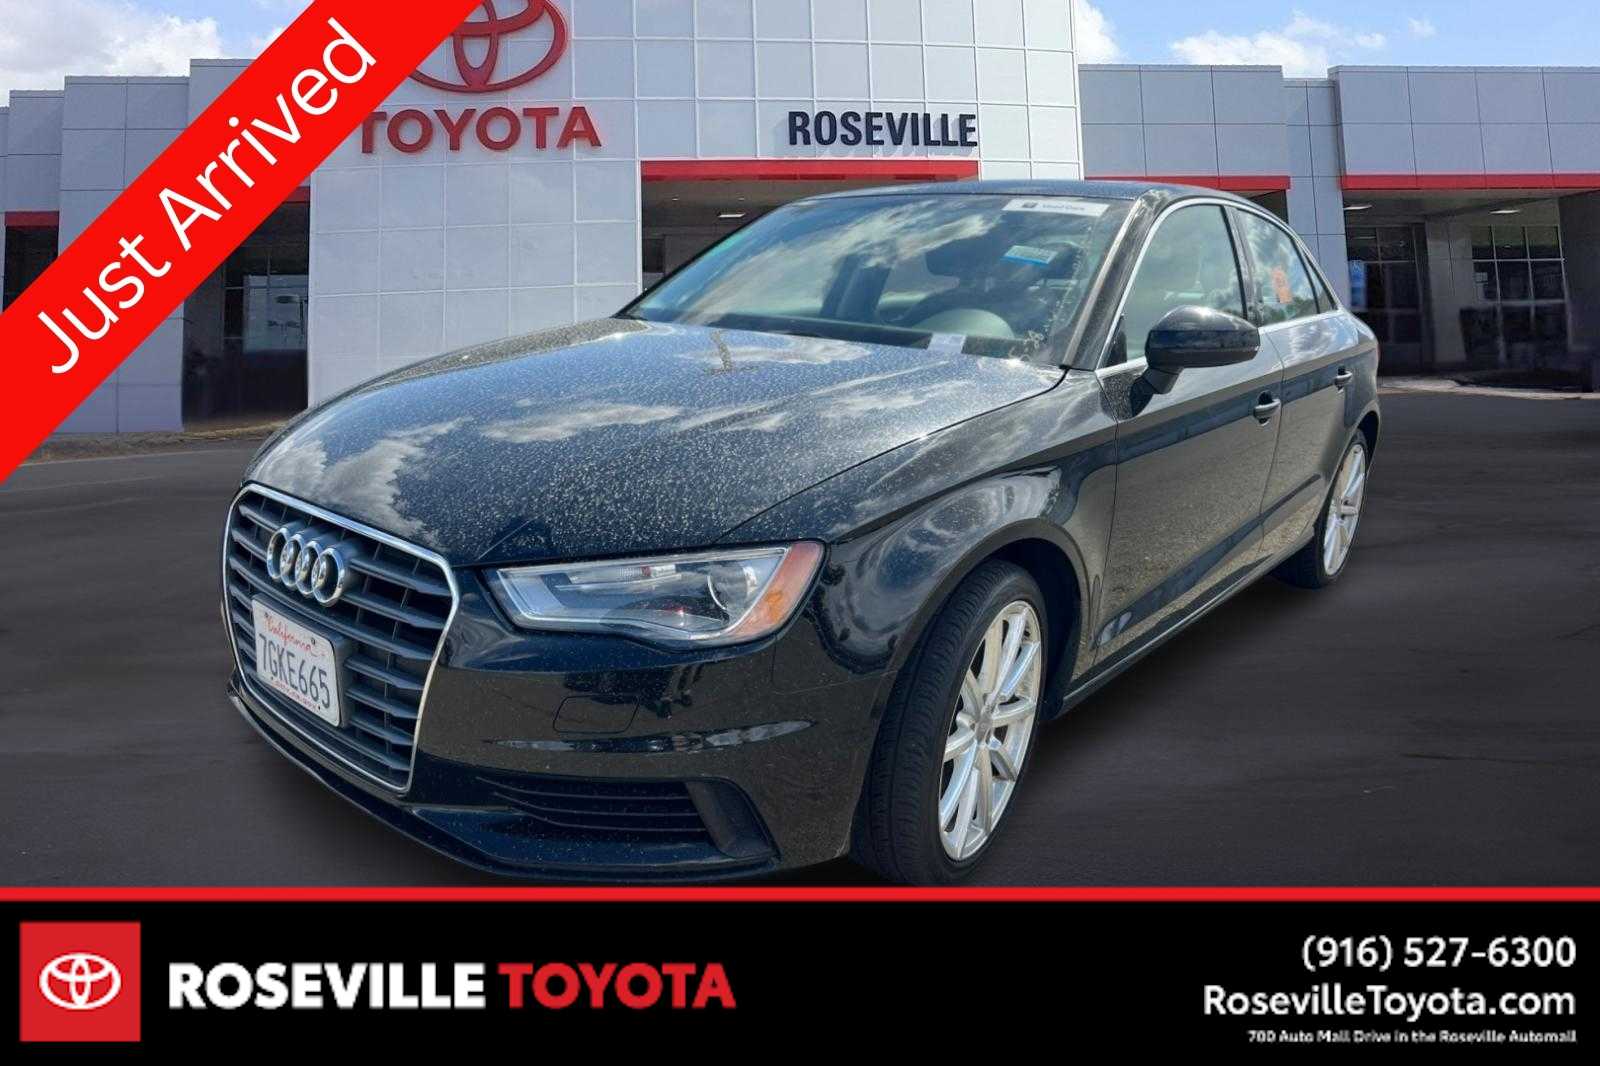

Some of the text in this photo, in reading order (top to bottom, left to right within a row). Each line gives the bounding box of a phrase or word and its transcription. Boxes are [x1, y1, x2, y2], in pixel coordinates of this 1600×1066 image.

[361, 105, 602, 154] TOYOTA
[788, 110, 978, 147] ROSEVILLE
[257, 633, 332, 710] 7GKE665
